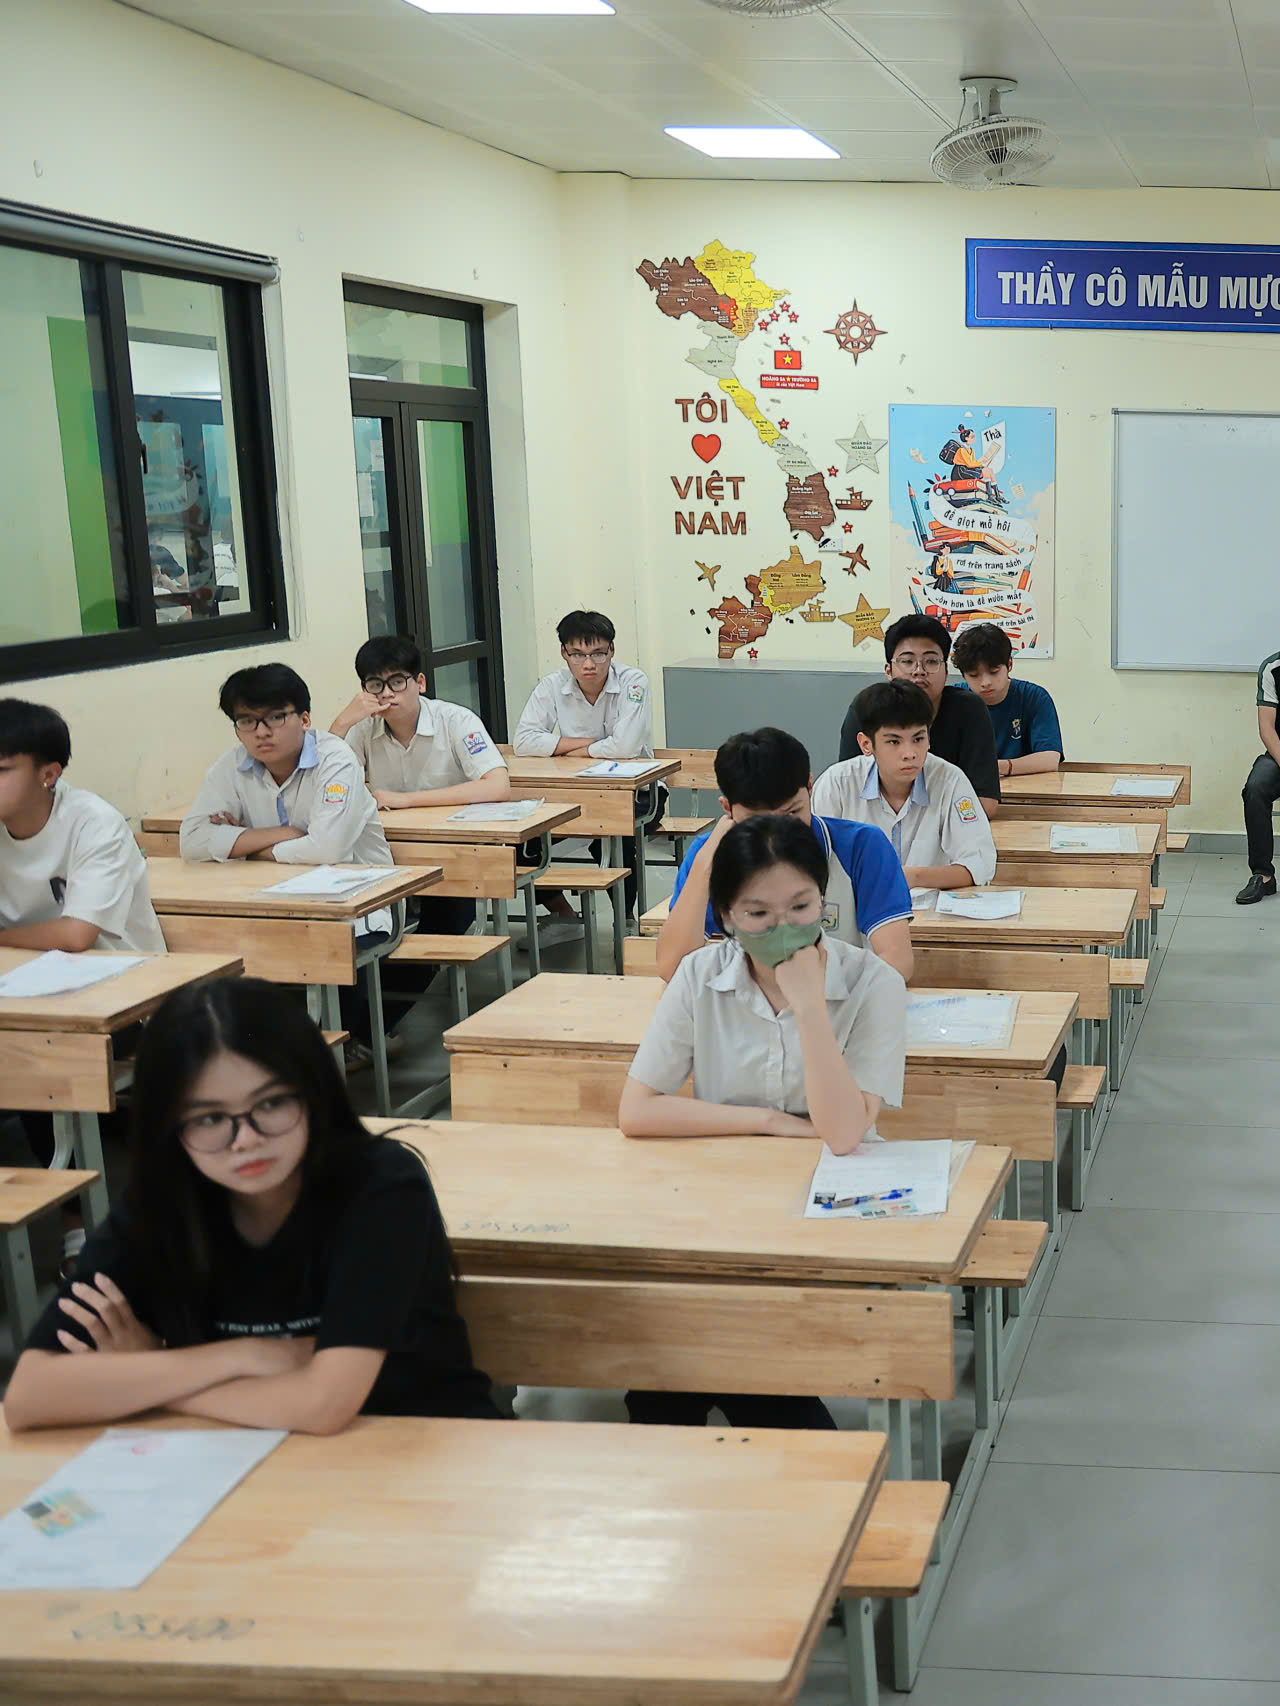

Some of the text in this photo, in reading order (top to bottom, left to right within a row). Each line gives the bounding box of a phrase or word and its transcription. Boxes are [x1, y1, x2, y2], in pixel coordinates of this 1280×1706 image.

[997, 260, 1076, 305] THẦY
[1085, 266, 1127, 307] CÔ
[1137, 262, 1208, 309] MẪU
[675, 392, 728, 423] TÔI
[984, 427, 1002, 443] Thà
[670, 470, 745, 506] VIỆT
[674, 511, 747, 535] NAM
[943, 509, 1011, 532] để giọt mồ hôi
[967, 561, 982, 569] trên
[984, 562, 1004, 570] trang
[1005, 558, 1022, 568] sách
[966, 599, 974, 608] là
[988, 594, 1004, 603] nước
